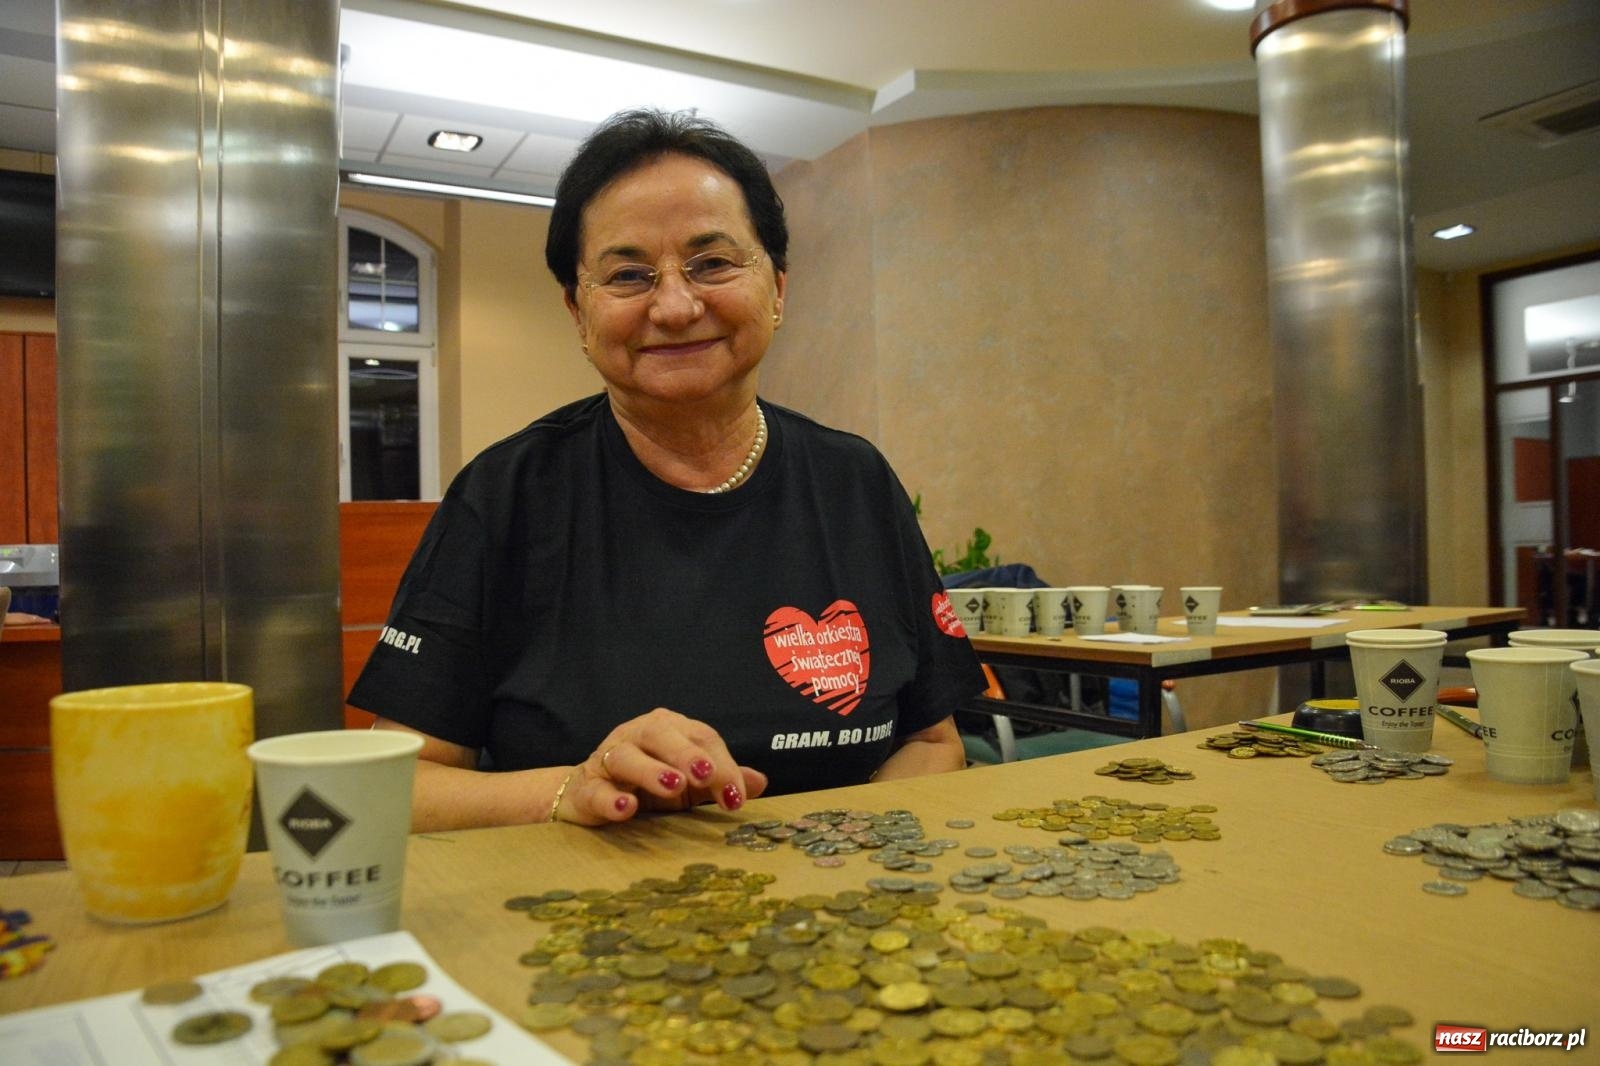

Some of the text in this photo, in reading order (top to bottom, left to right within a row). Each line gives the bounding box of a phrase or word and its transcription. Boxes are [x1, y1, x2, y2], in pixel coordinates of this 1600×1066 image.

[774, 619, 862, 648] wielka orkiestra
[791, 646, 863, 674] świątecznej
[811, 671, 860, 697] pomocy
[1368, 705, 1434, 717] COFFEE
[771, 731, 832, 750] GRAM,
[837, 728, 862, 746] BO
